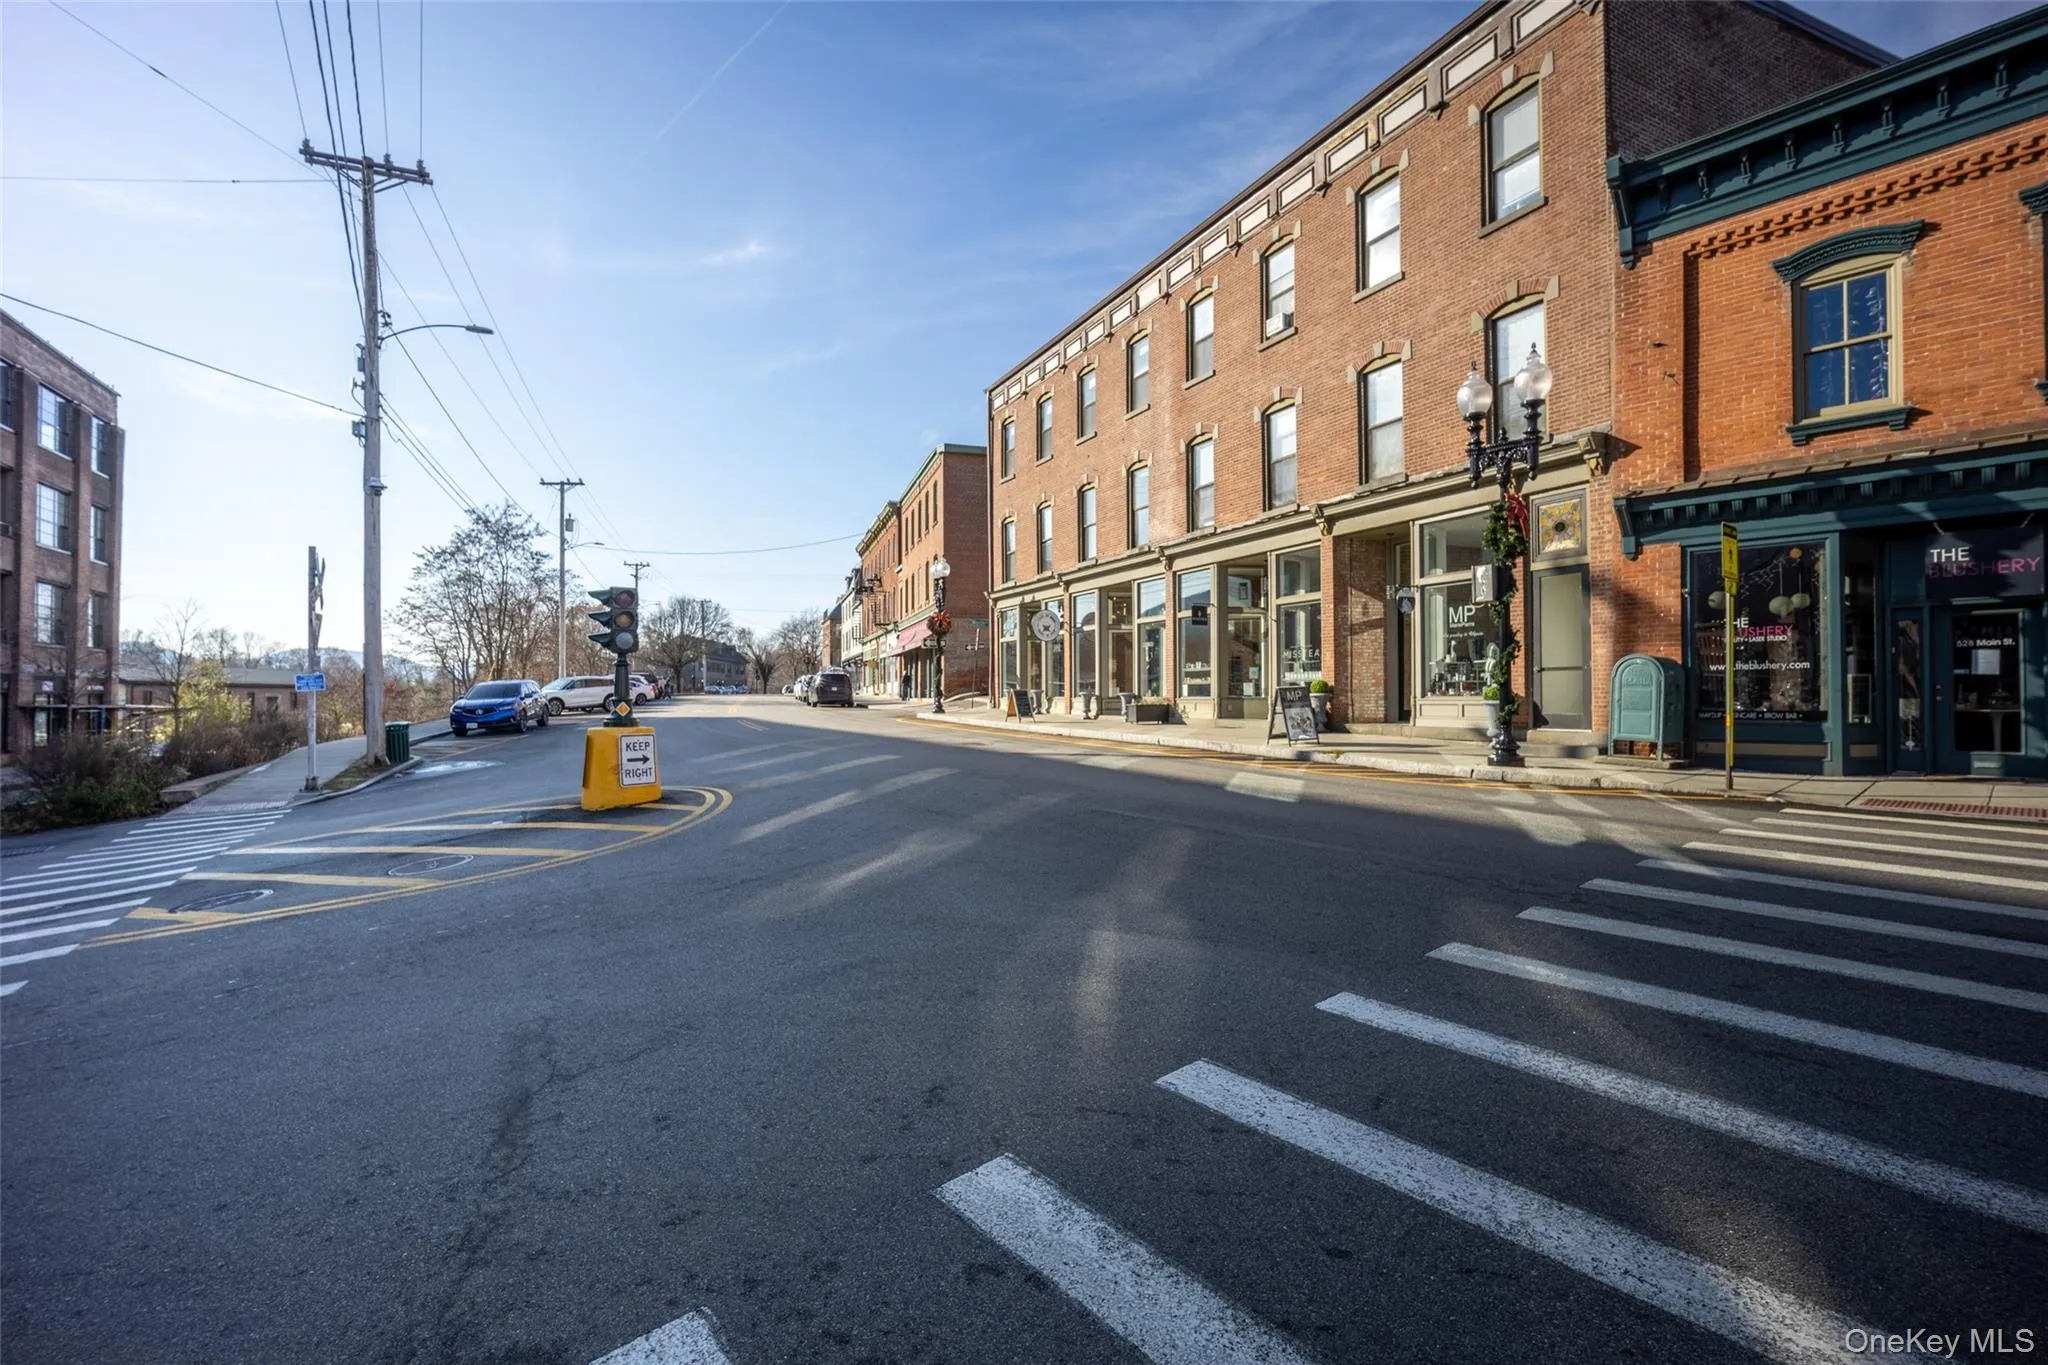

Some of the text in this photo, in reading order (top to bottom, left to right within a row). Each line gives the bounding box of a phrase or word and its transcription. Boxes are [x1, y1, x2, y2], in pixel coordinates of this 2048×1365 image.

[1930, 546, 1970, 562] THE
[1928, 556, 2040, 578] BLUSHERY
[1449, 605, 1475, 623] MP
[1726, 617, 1749, 628] HE
[1738, 625, 1793, 638] USHERY
[2002, 638, 2016, 646] St.
[1709, 661, 1811, 671] ww.theblushery.com
[1286, 690, 1302, 701] MP
[626, 741, 650, 752] KEEP
[625, 767, 653, 779] RIGHT
